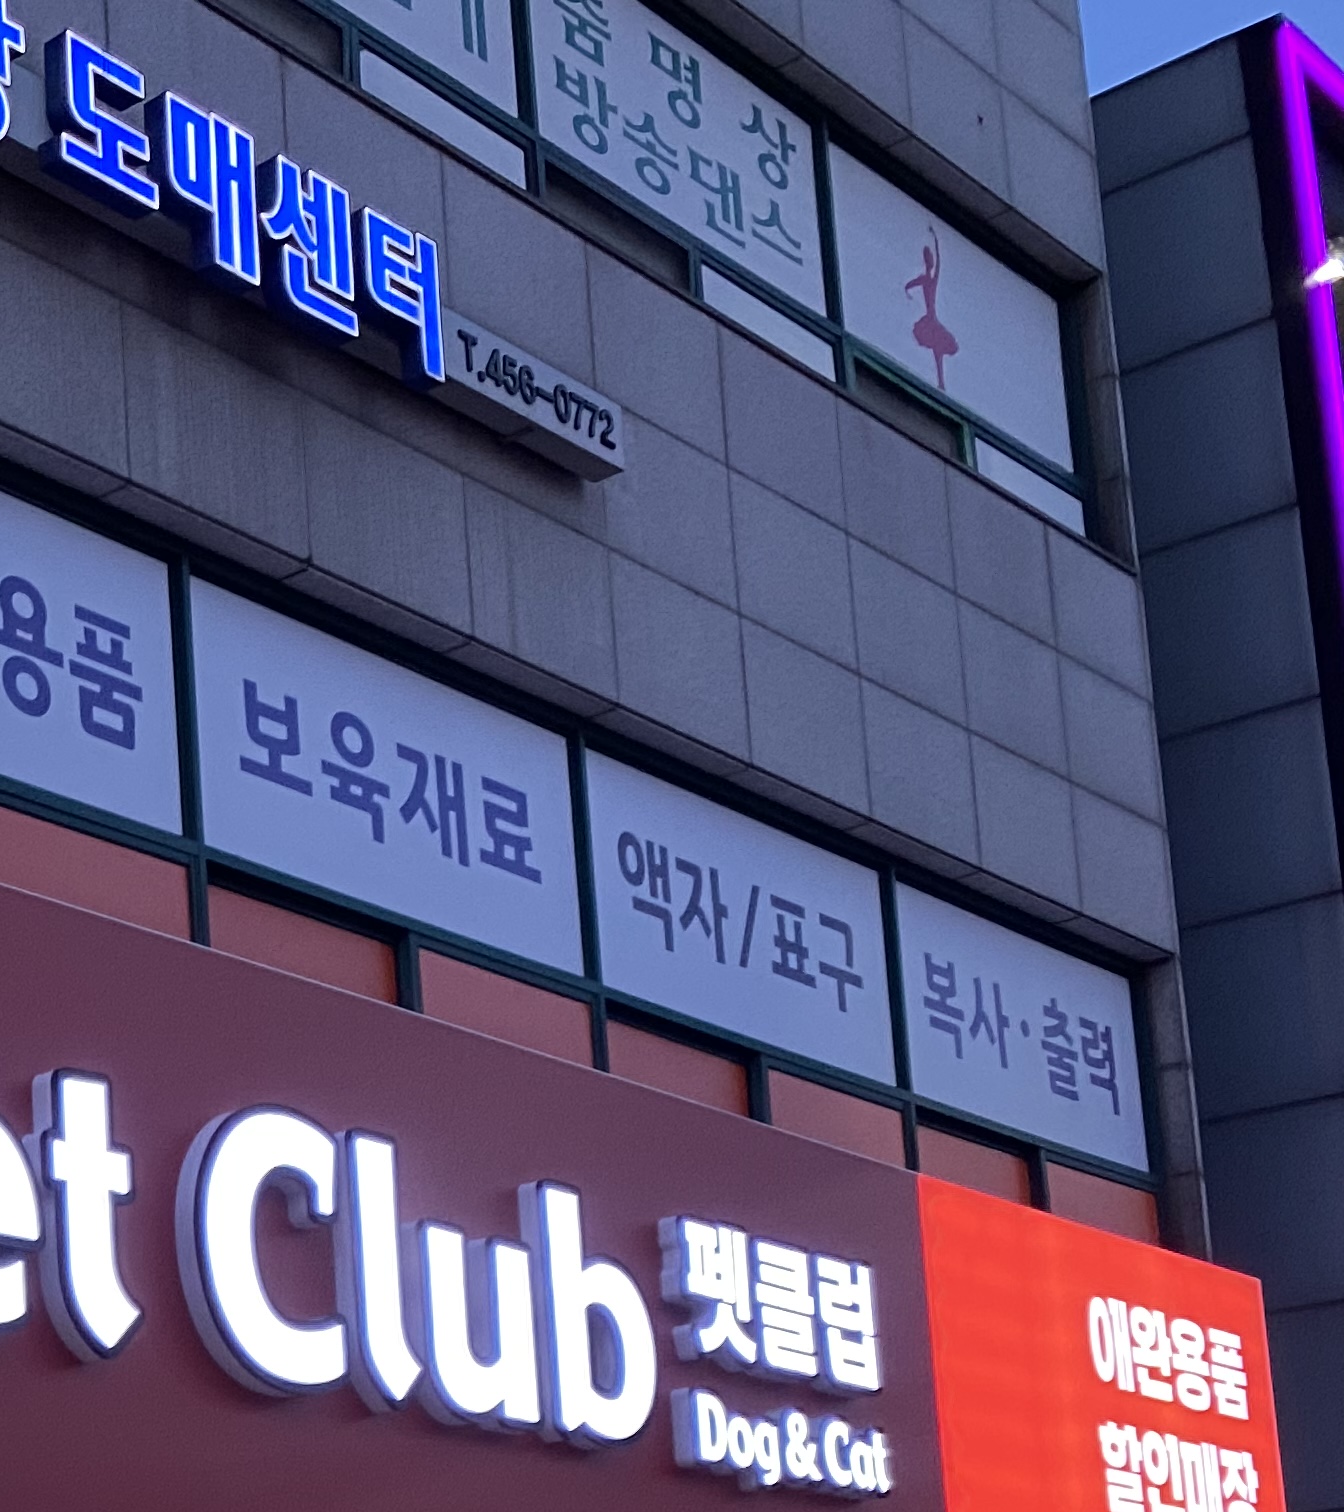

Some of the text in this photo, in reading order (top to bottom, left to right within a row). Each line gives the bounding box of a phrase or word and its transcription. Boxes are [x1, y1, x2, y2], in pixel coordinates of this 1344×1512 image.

[50, 28, 446, 384] 도매센터
[552, 54, 804, 267] 방송댄스
[457, 329, 617, 451] T.456-0772
[238, 678, 543, 885] 보육재료
[617, 830, 864, 1013] 액자/표구
[178, 1105, 657, 1445] Club
[664, 1216, 882, 1392] 펫클럽
[1088, 1296, 1250, 1421] 애완용품
